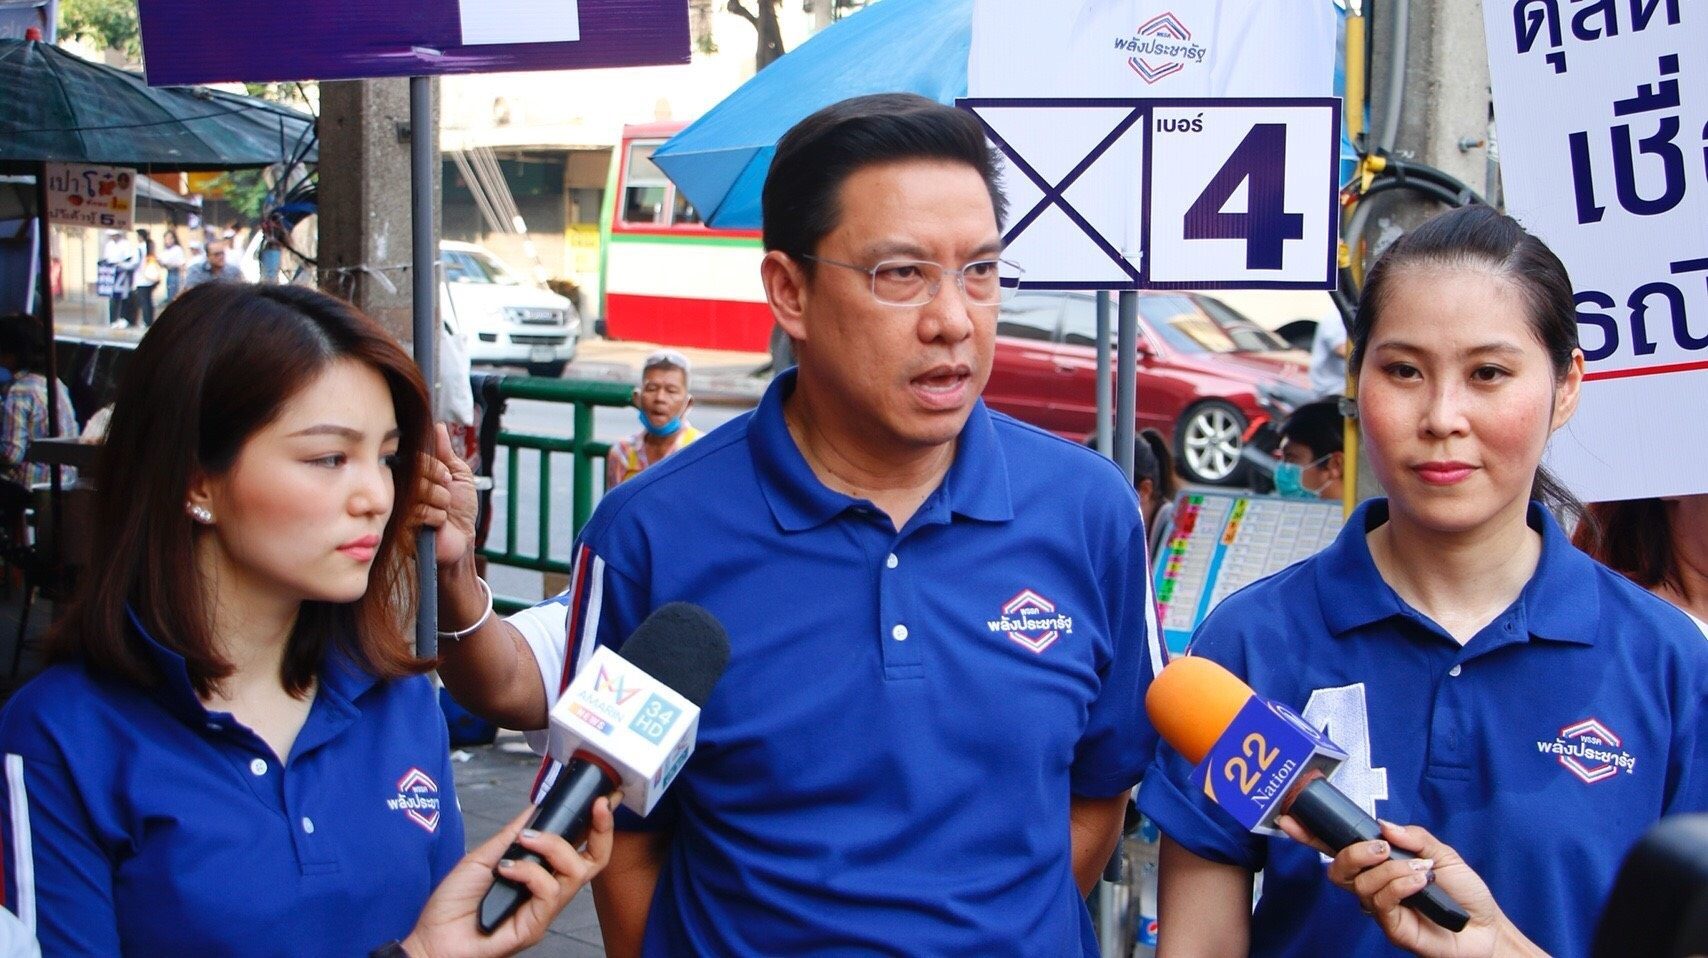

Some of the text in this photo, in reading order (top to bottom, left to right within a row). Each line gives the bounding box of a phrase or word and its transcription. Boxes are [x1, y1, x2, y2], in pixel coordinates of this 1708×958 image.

[1113, 36, 1206, 63] พลังประชารัฐ
[1156, 112, 1204, 133] เบอร์
[1568, 53, 1708, 225] เชื่
[1183, 123, 1304, 271] 4
[100, 213, 115, 226] 5
[987, 613, 1073, 634] พลังประชารัฐ
[646, 700, 674, 725] 34
[636, 714, 664, 738] HD
[1580, 735, 1603, 746] พรรค
[1224, 732, 1280, 795] 22
[1537, 737, 1636, 775] พลังประชารัฐ
[1250, 758, 1297, 809] Nation
